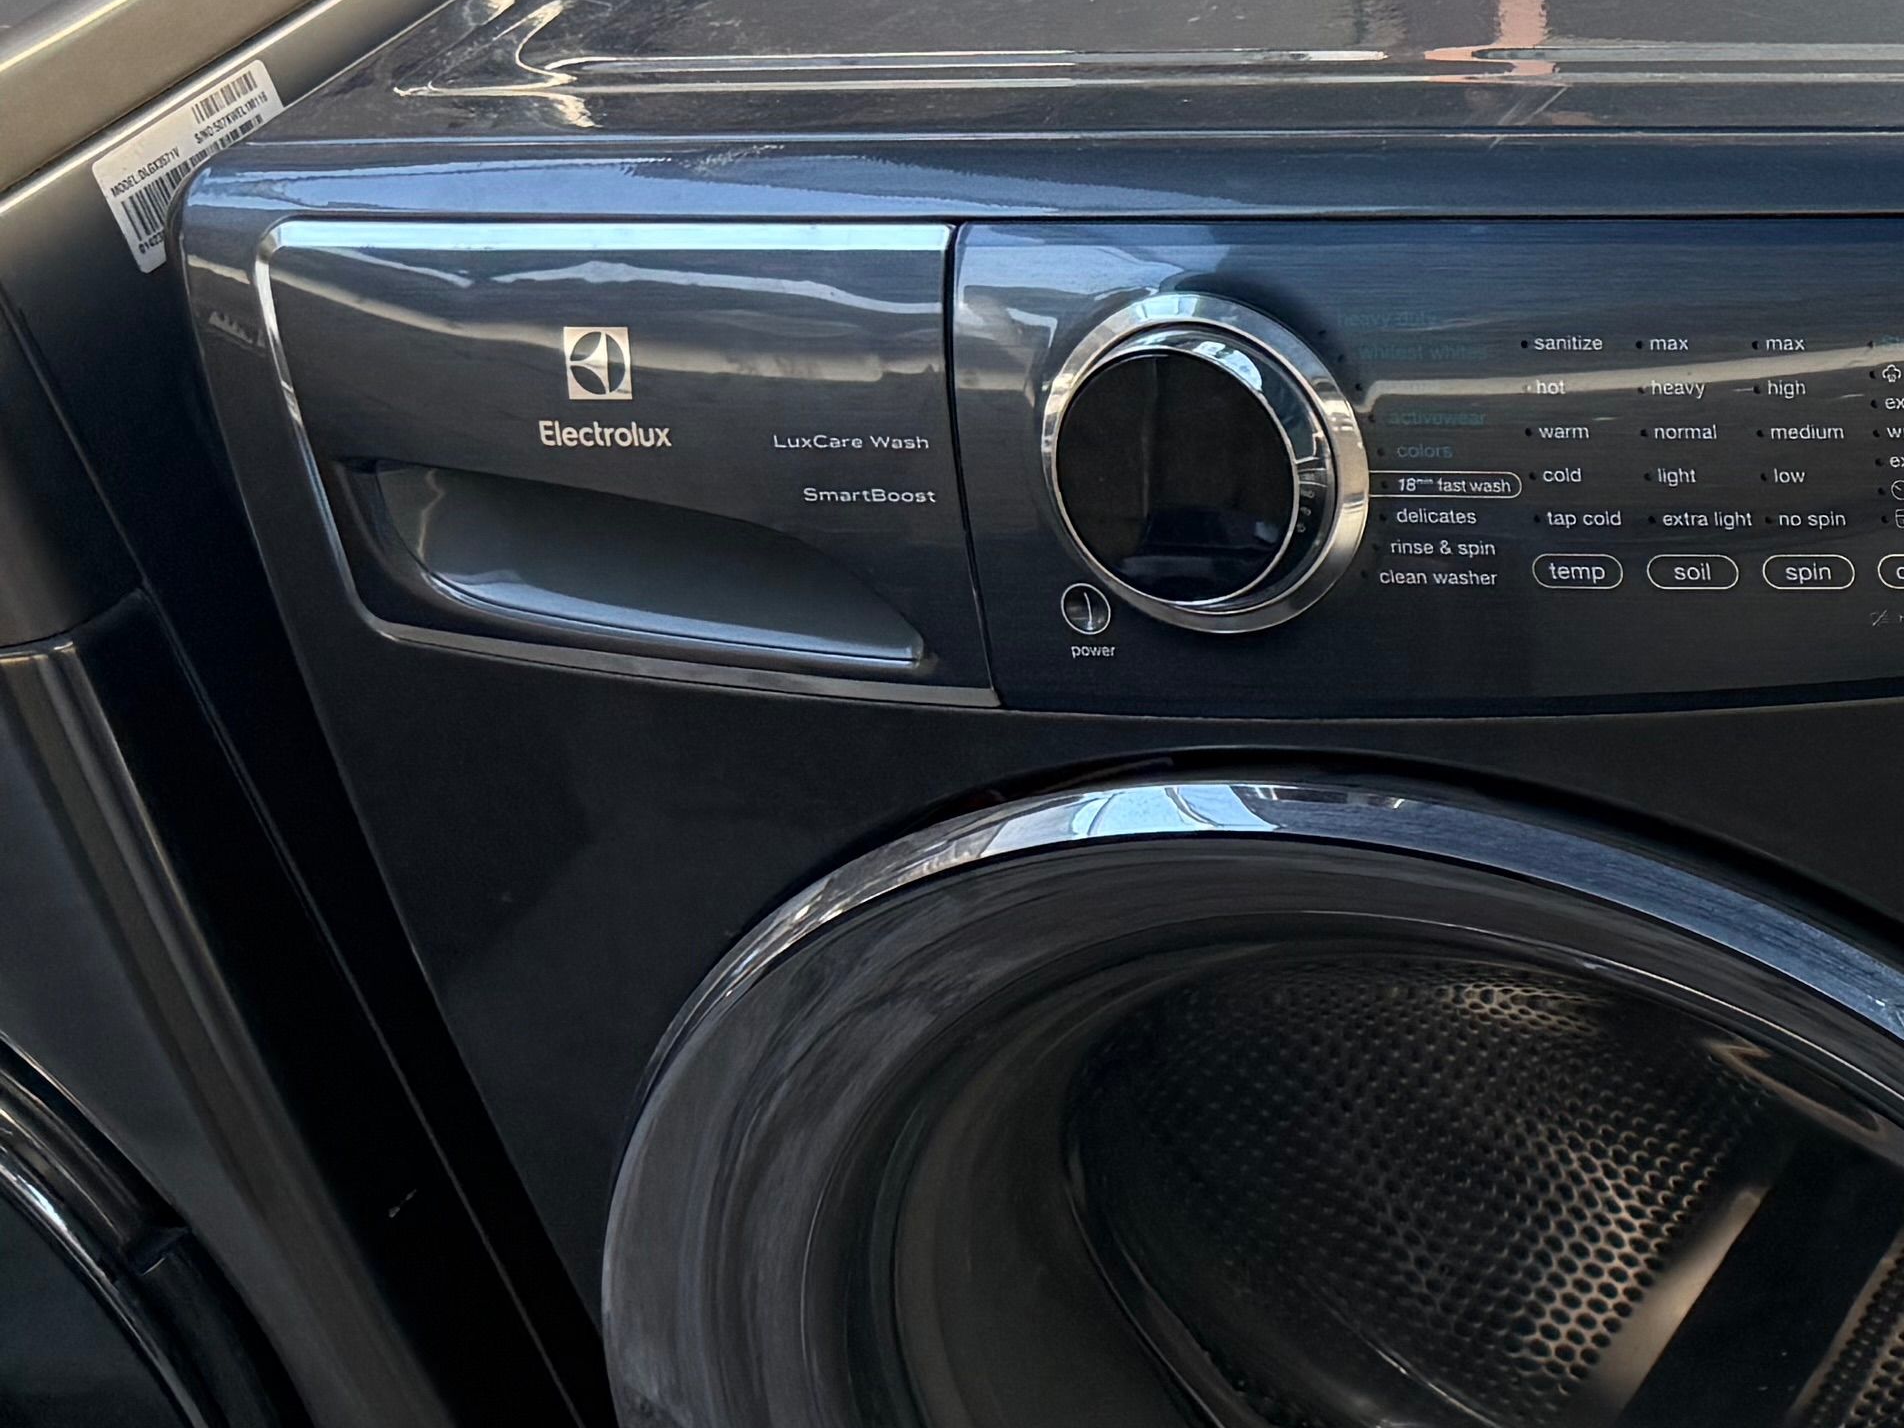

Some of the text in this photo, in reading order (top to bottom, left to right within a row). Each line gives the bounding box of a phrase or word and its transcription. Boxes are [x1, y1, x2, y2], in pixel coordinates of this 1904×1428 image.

[1534, 335, 1603, 351] sanitize
[1649, 338, 1689, 351] max
[1766, 338, 1806, 351] max
[1535, 379, 1566, 395] hot
[1650, 380, 1706, 399] heavy
[1767, 379, 1807, 399] high
[538, 419, 672, 449] Electrolux
[1538, 426, 1590, 440] warm
[1654, 424, 1717, 440] normal
[1770, 424, 1844, 440] medium
[772, 433, 930, 450] LuxCare Wash
[1396, 443, 1454, 459] colors
[1542, 467, 1582, 483] cold
[1657, 467, 1697, 487] light
[1773, 467, 1806, 484] low
[1470, 479, 1512, 493] wash
[803, 487, 937, 504] SmartBoost
[1396, 508, 1477, 524] delicates
[1546, 510, 1622, 528] tap cold
[1662, 511, 1753, 530] extra light
[1778, 512, 1847, 530] no spin
[1391, 539, 1496, 559] rinse & spin
[1379, 569, 1498, 586] clean washer
[1548, 562, 1606, 585] temp
[1673, 562, 1712, 581] soil
[1785, 562, 1832, 585] spin
[1070, 645, 1116, 659] power
